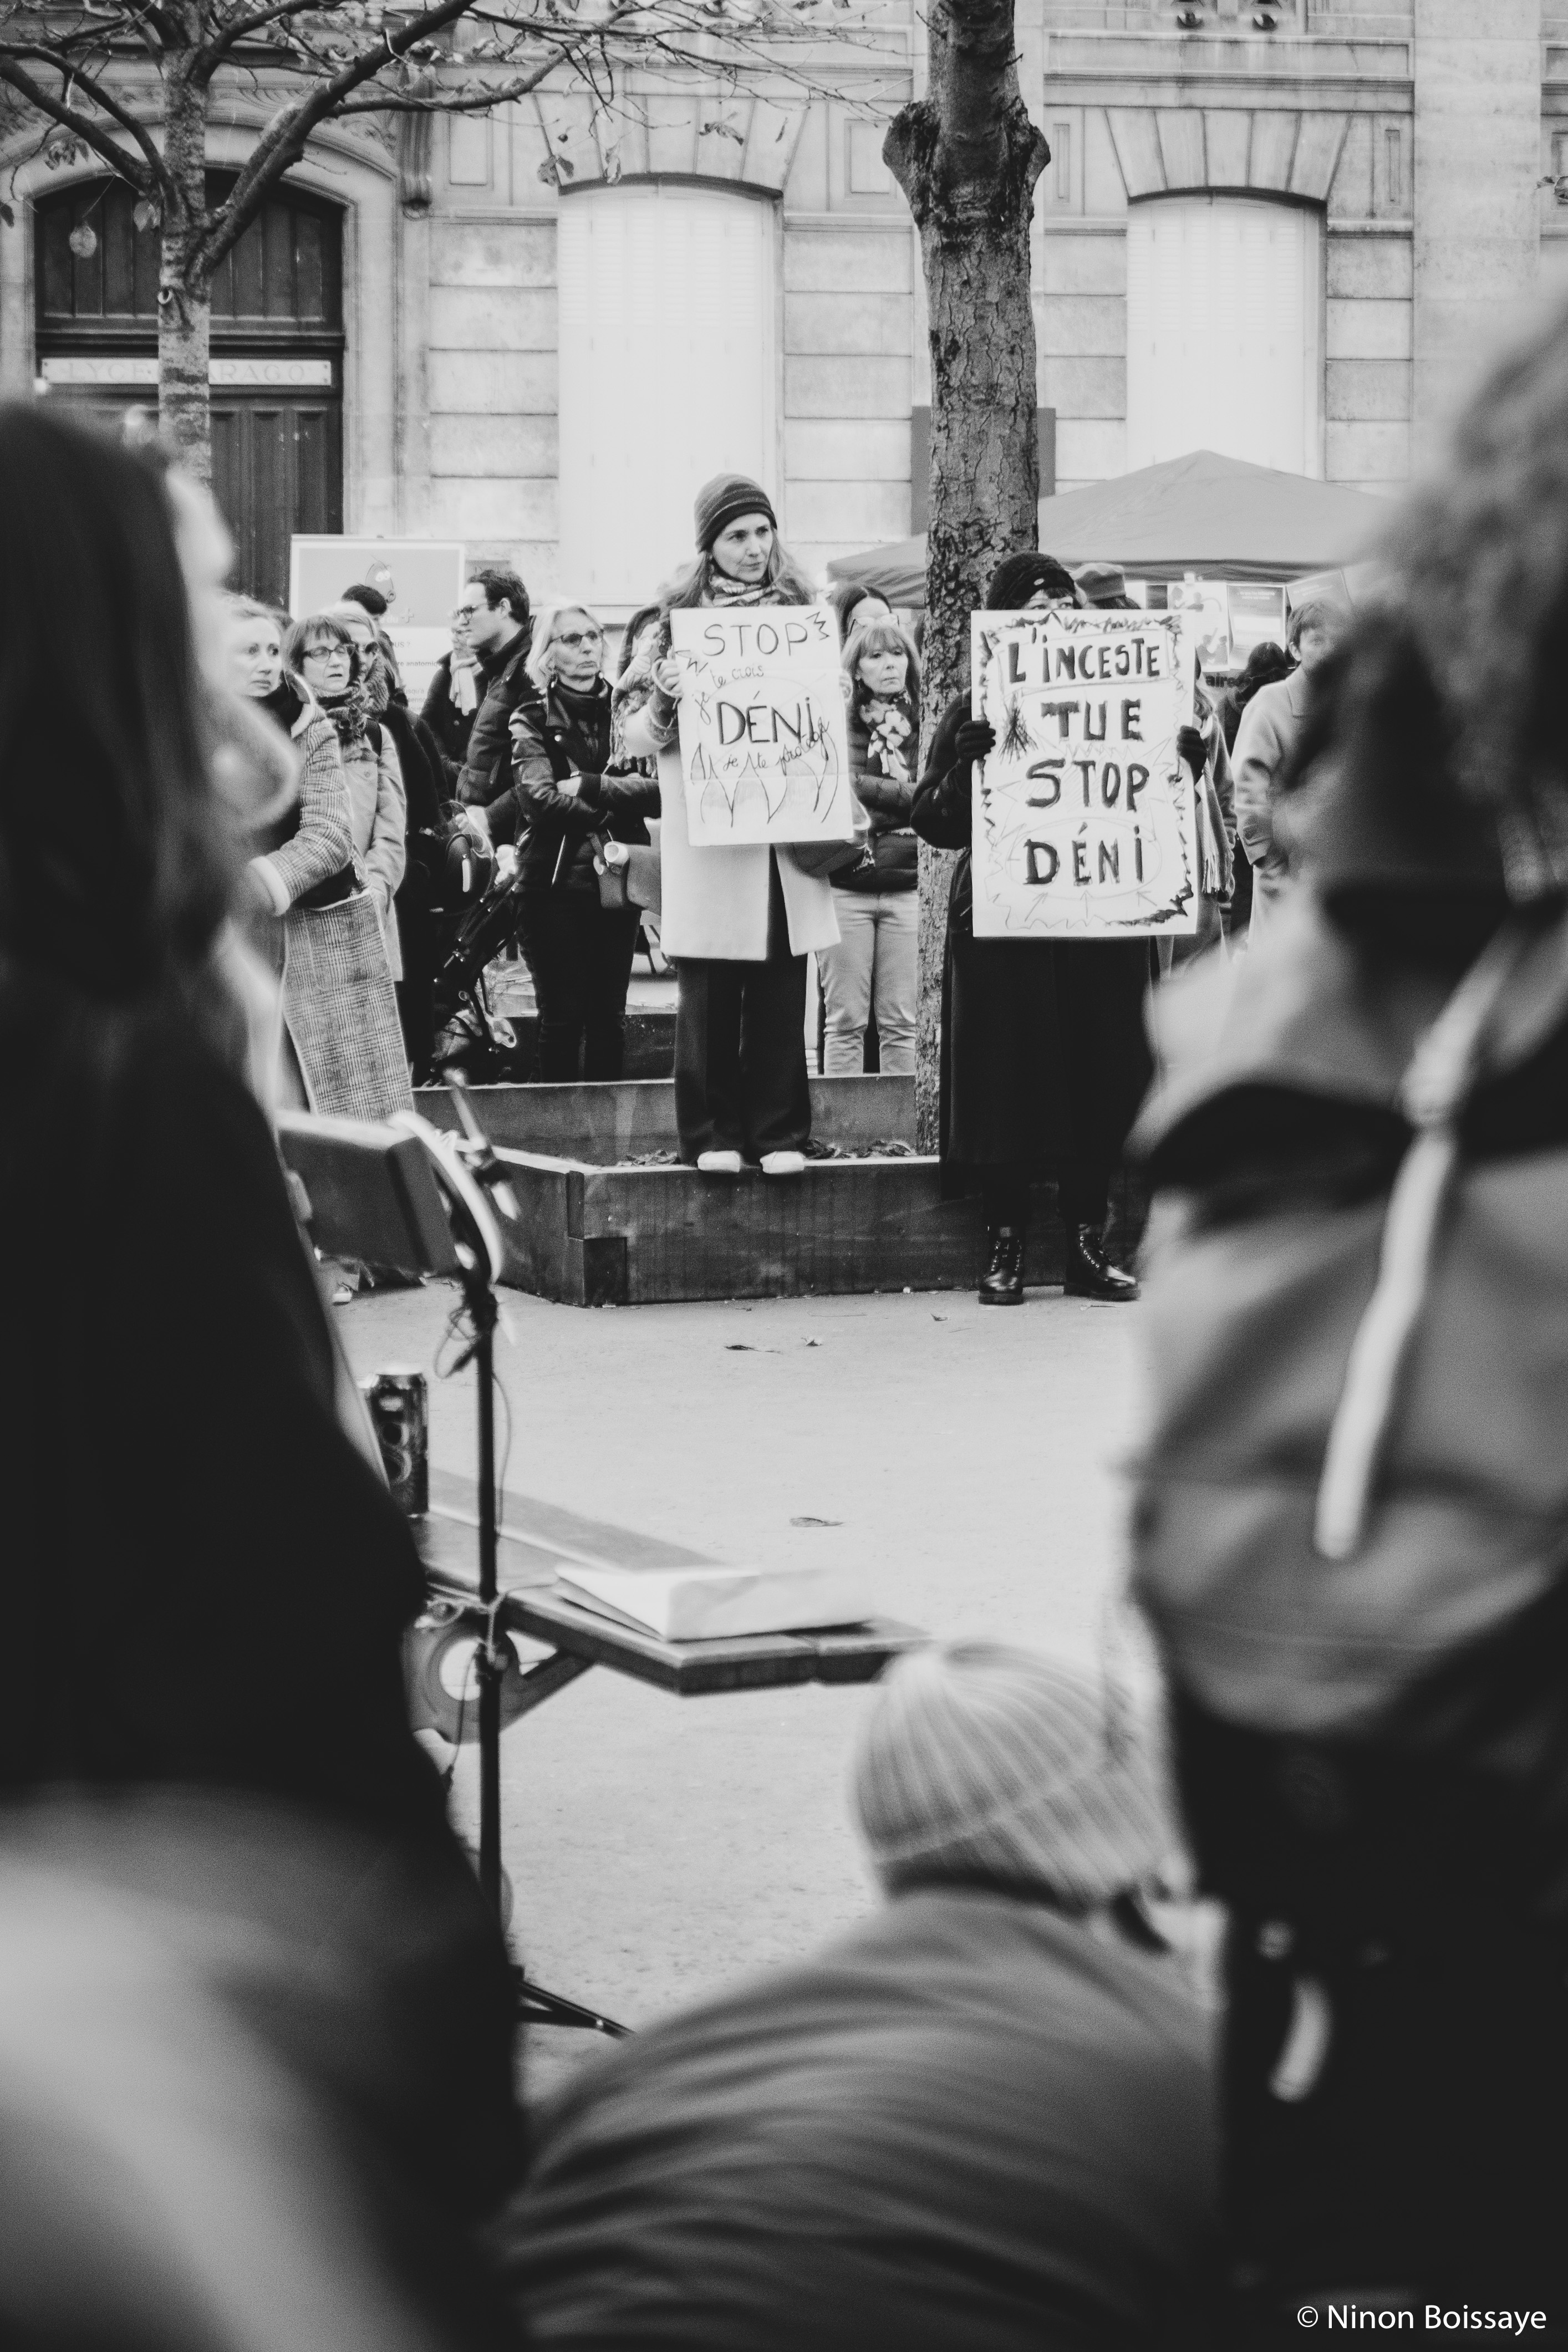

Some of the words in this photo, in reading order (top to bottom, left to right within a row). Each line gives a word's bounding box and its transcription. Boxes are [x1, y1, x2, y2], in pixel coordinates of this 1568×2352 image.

[69, 363, 147, 380] LYCE
[702, 623, 808, 656] STOP
[1040, 698, 1144, 742] TUE
[1026, 758, 1150, 812] STOP
